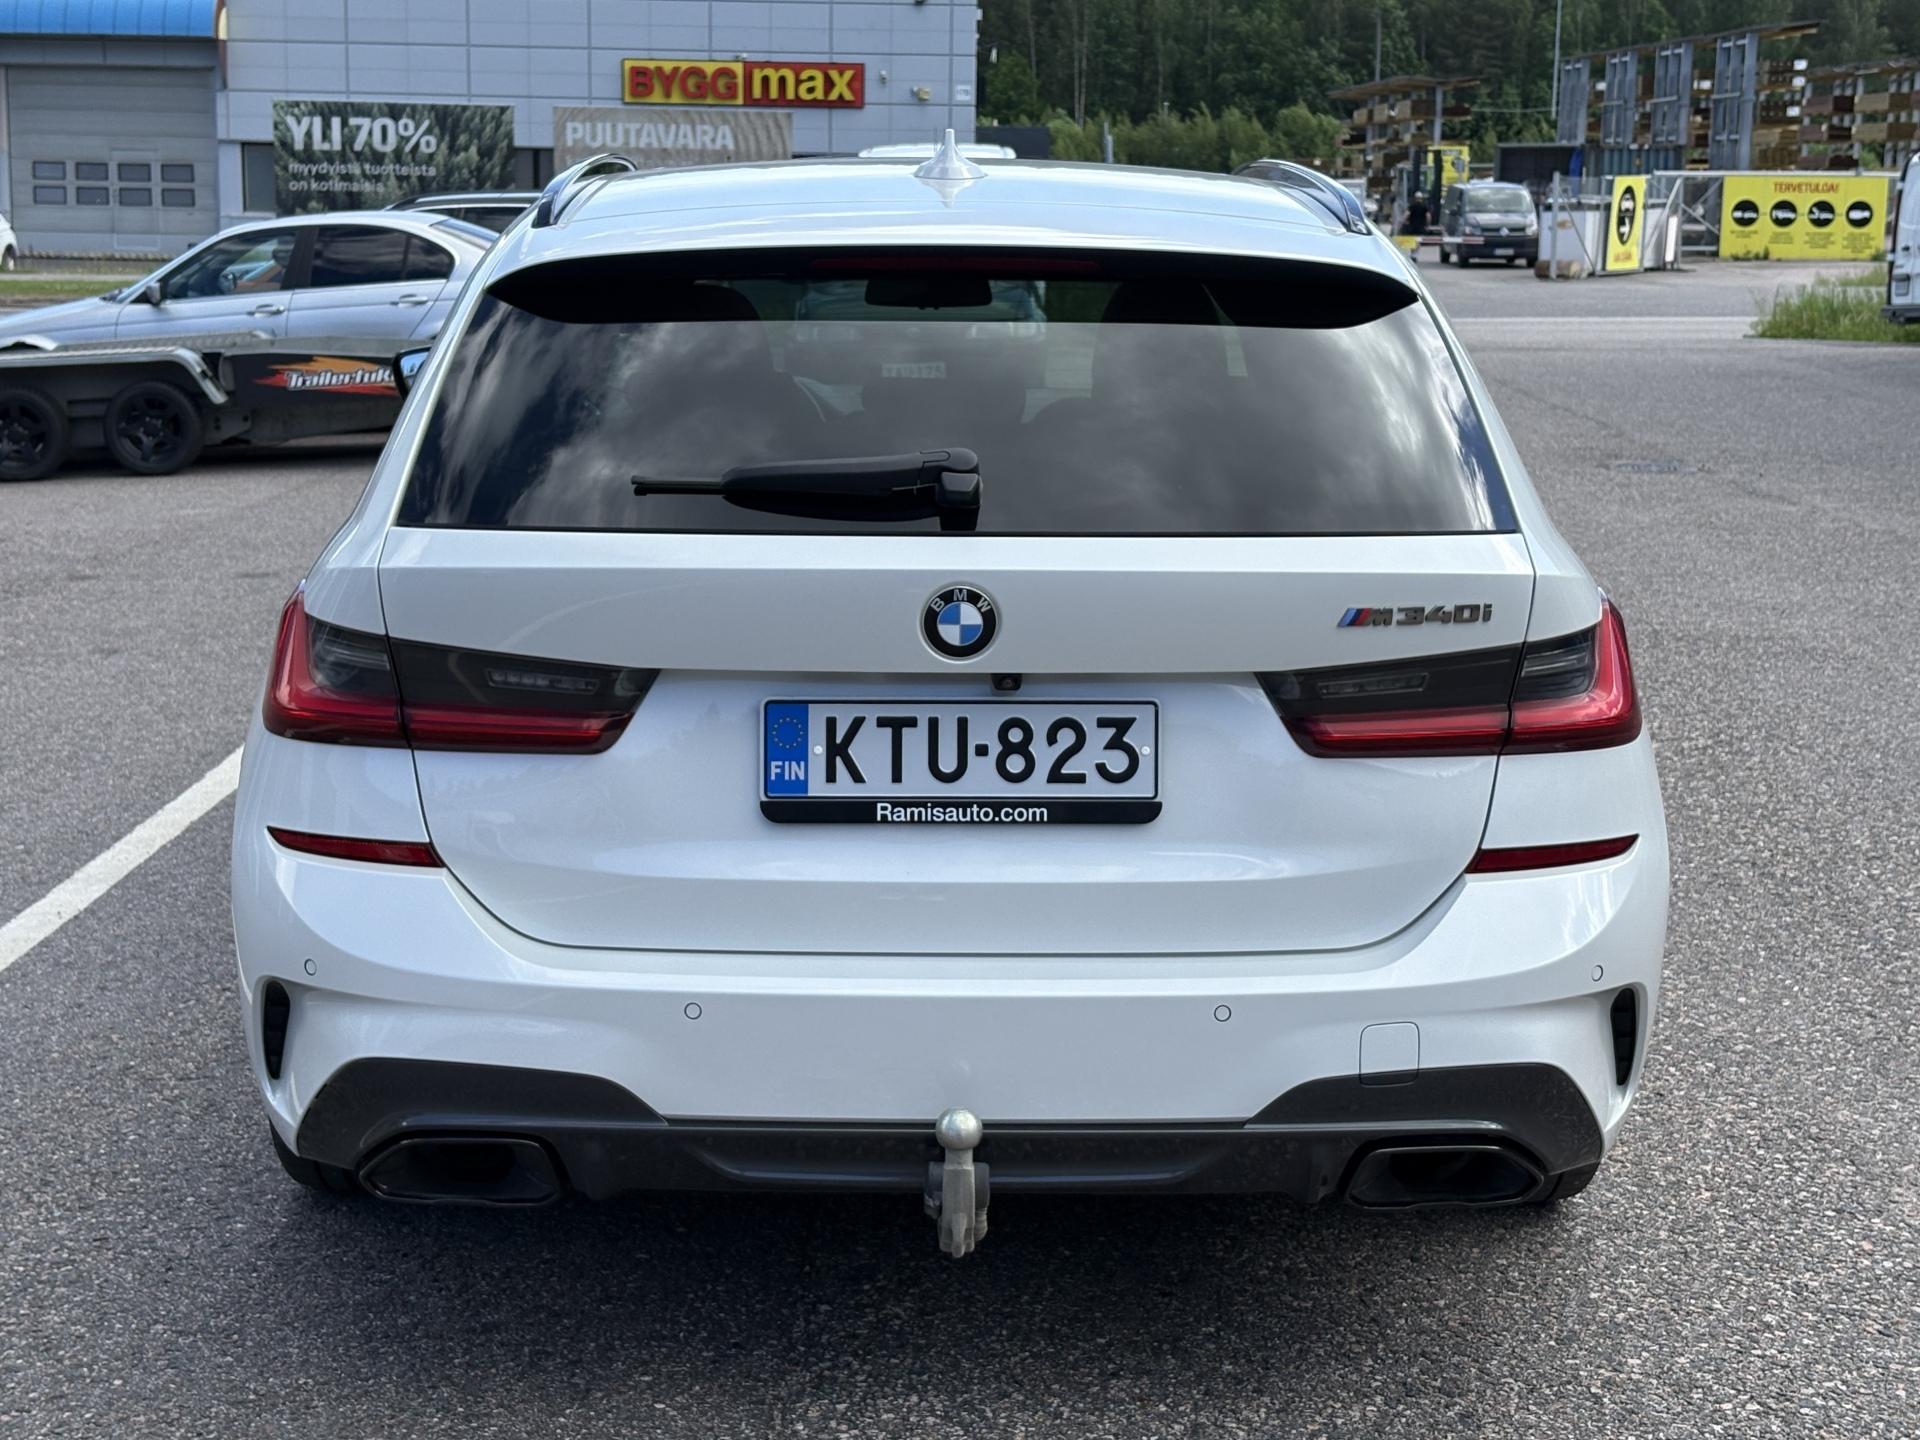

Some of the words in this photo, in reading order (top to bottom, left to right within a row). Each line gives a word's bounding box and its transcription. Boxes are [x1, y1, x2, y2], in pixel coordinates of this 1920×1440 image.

[629, 66, 739, 99] BYGG
[751, 67, 856, 101] max
[286, 116, 342, 150] YLI
[350, 117, 437, 153] 70%
[565, 121, 736, 149] PUUTAVARA
[366, 164, 437, 176] tuotteista
[289, 180, 307, 191] on
[1774, 182, 1839, 194] TERVETULOA!
[286, 368, 395, 391] Trailertuk
[930, 589, 991, 612] BMW
[1364, 603, 1493, 626] M340i
[825, 716, 1140, 784] KTU-823
[770, 761, 804, 780] FIN
[876, 803, 1047, 824] Ramisauto.com
